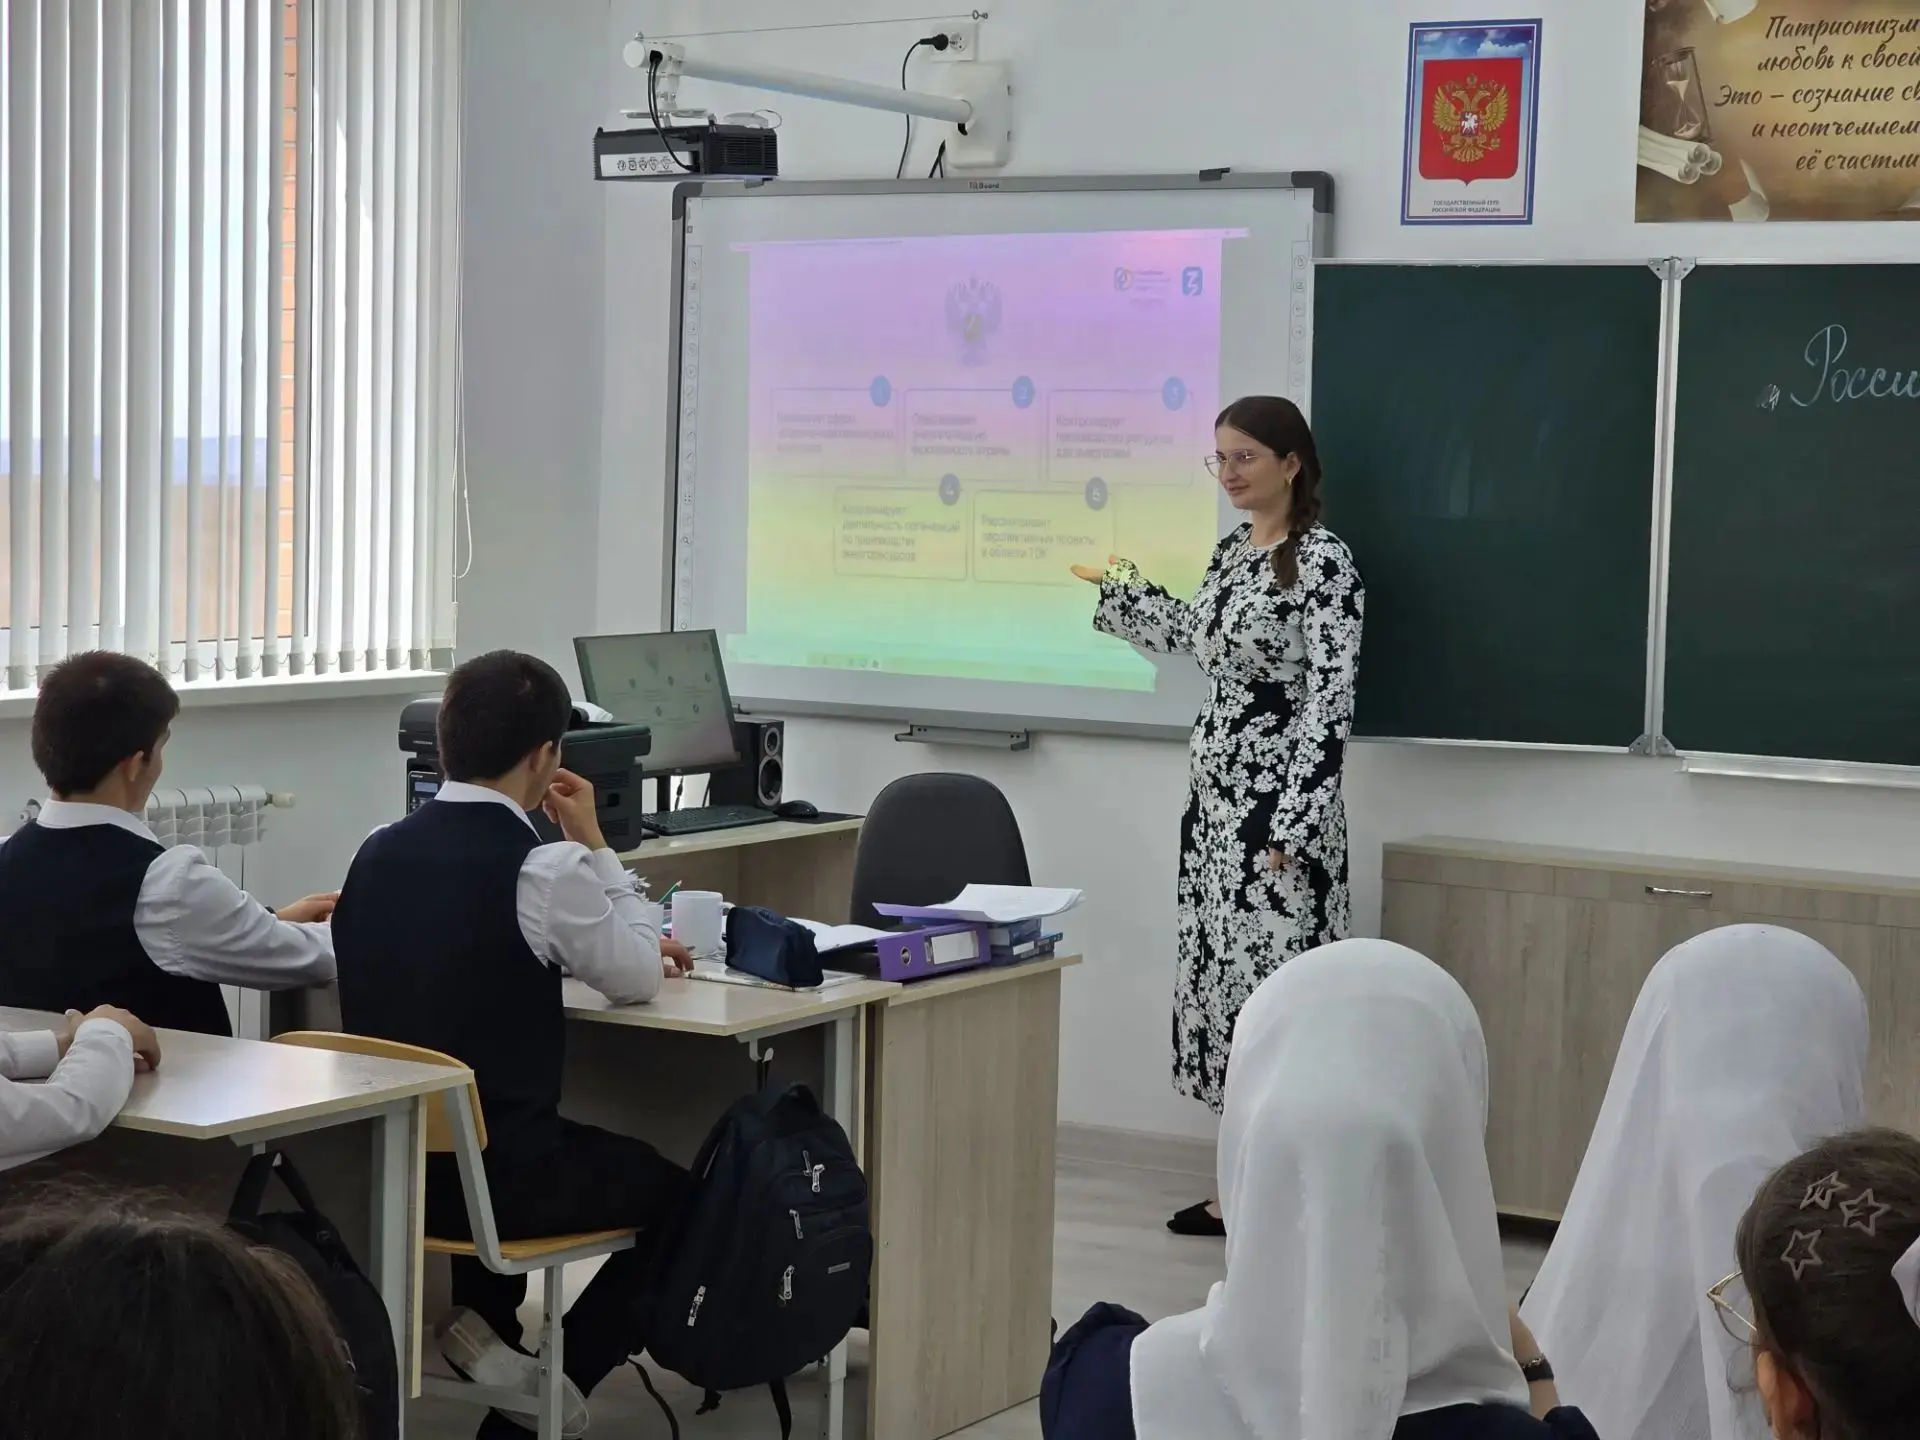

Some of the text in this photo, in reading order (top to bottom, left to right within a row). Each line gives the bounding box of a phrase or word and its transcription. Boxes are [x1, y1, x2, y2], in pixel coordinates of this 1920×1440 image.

[1766, 16, 1920, 44] Патриотизм
[1757, 45, 1834, 71] любовь
[1841, 54, 1853, 70] к
[1714, 84, 1763, 107] Это
[1792, 85, 1895, 112] сознание
[1752, 119, 1920, 138] и неотъемлем
[1796, 149, 1920, 170] её счастли
